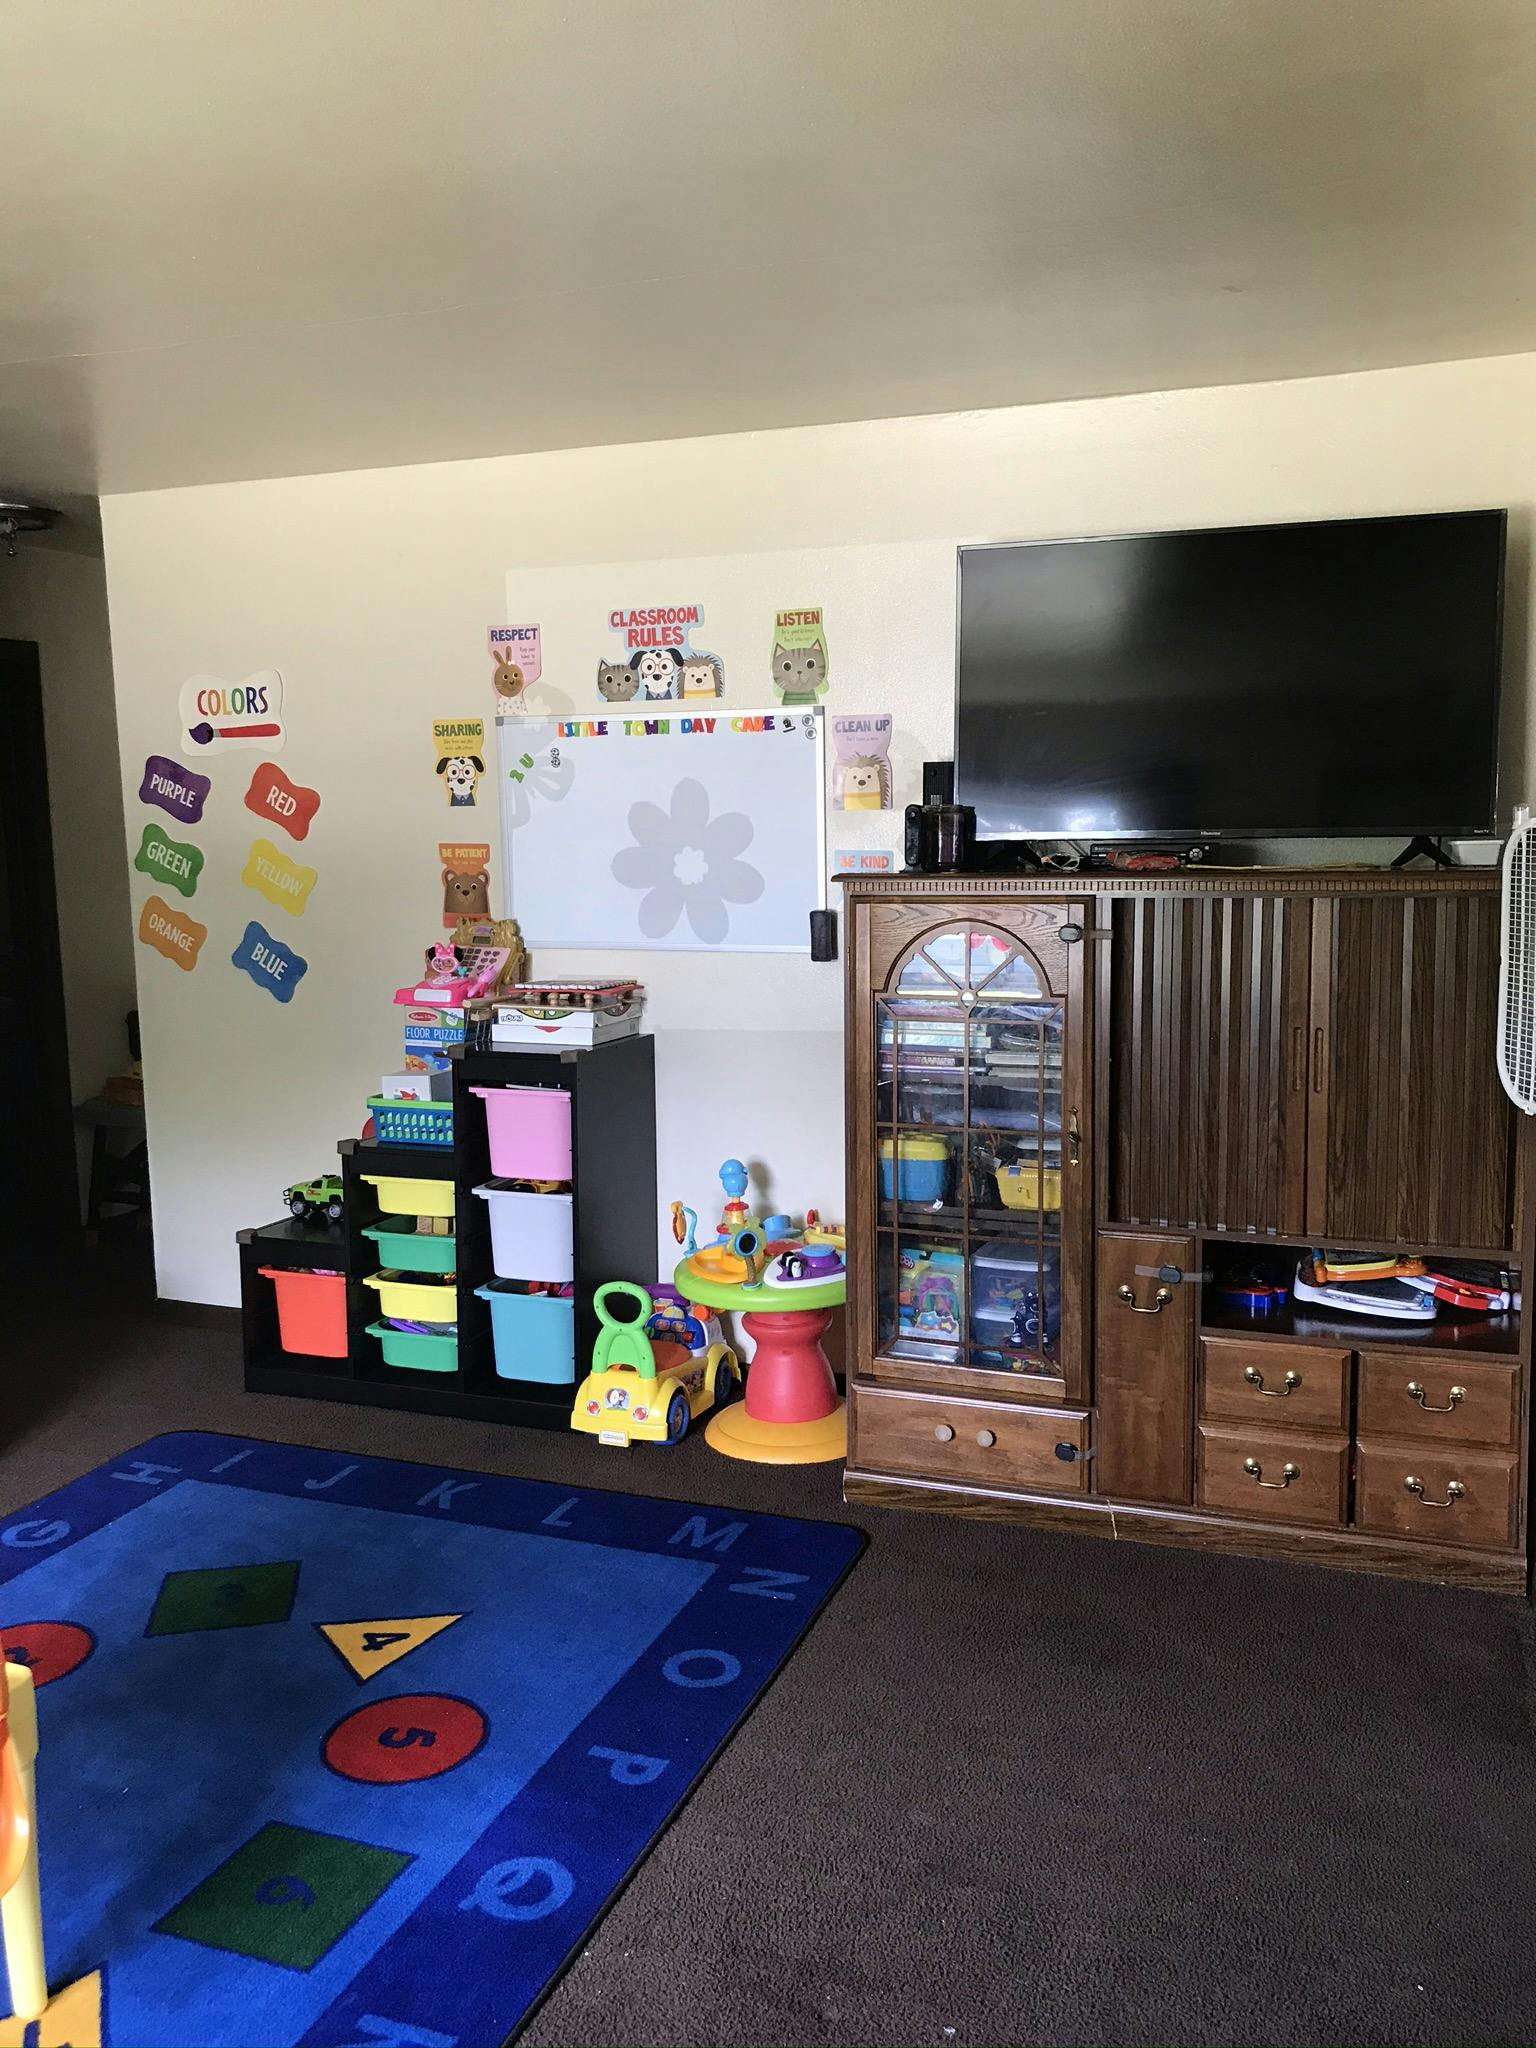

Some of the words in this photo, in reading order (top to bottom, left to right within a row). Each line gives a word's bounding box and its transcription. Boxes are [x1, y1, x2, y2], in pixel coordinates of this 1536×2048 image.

[610, 606, 699, 628] CLASSROOM
[776, 610, 820, 627] LISTEN
[490, 627, 538, 642] RESPECT
[627, 625, 685, 648] RULES
[197, 686, 269, 716] COLORS
[434, 723, 482, 737] SHARING
[558, 720, 608, 737] LITTLE
[623, 719, 670, 736] TOWN
[680, 717, 716, 733] DAY
[731, 715, 775, 732] CARE
[834, 719, 872, 733] CLEAN
[875, 719, 890, 732] UP
[149, 773, 196, 809] PURPLE
[265, 784, 298, 817] RED
[146, 841, 193, 879] GREEN
[441, 848, 453, 858] BE
[455, 848, 487, 858] PATIENT
[839, 855, 856, 868] BE
[860, 854, 890, 869] KIND
[255, 856, 305, 897] YELLOW
[149, 913, 195, 953] ORANGE
[250, 942, 289, 981] BLUE
[406, 1027, 431, 1039] FLOOR
[433, 1028, 464, 1041] PUZZLE
[110, 1461, 182, 1486] H
[303, 1465, 359, 1490] J
[416, 1479, 481, 1510] K
[541, 1497, 581, 1527] L
[1, 1519, 71, 1548] G
[667, 1515, 749, 1552] M
[727, 1566, 811, 1600] N
[361, 1631, 411, 1652] 4
[662, 1648, 742, 1688] O
[378, 1726, 437, 1749] 5
[588, 1744, 671, 1786] P
[458, 1855, 576, 1920] Q
